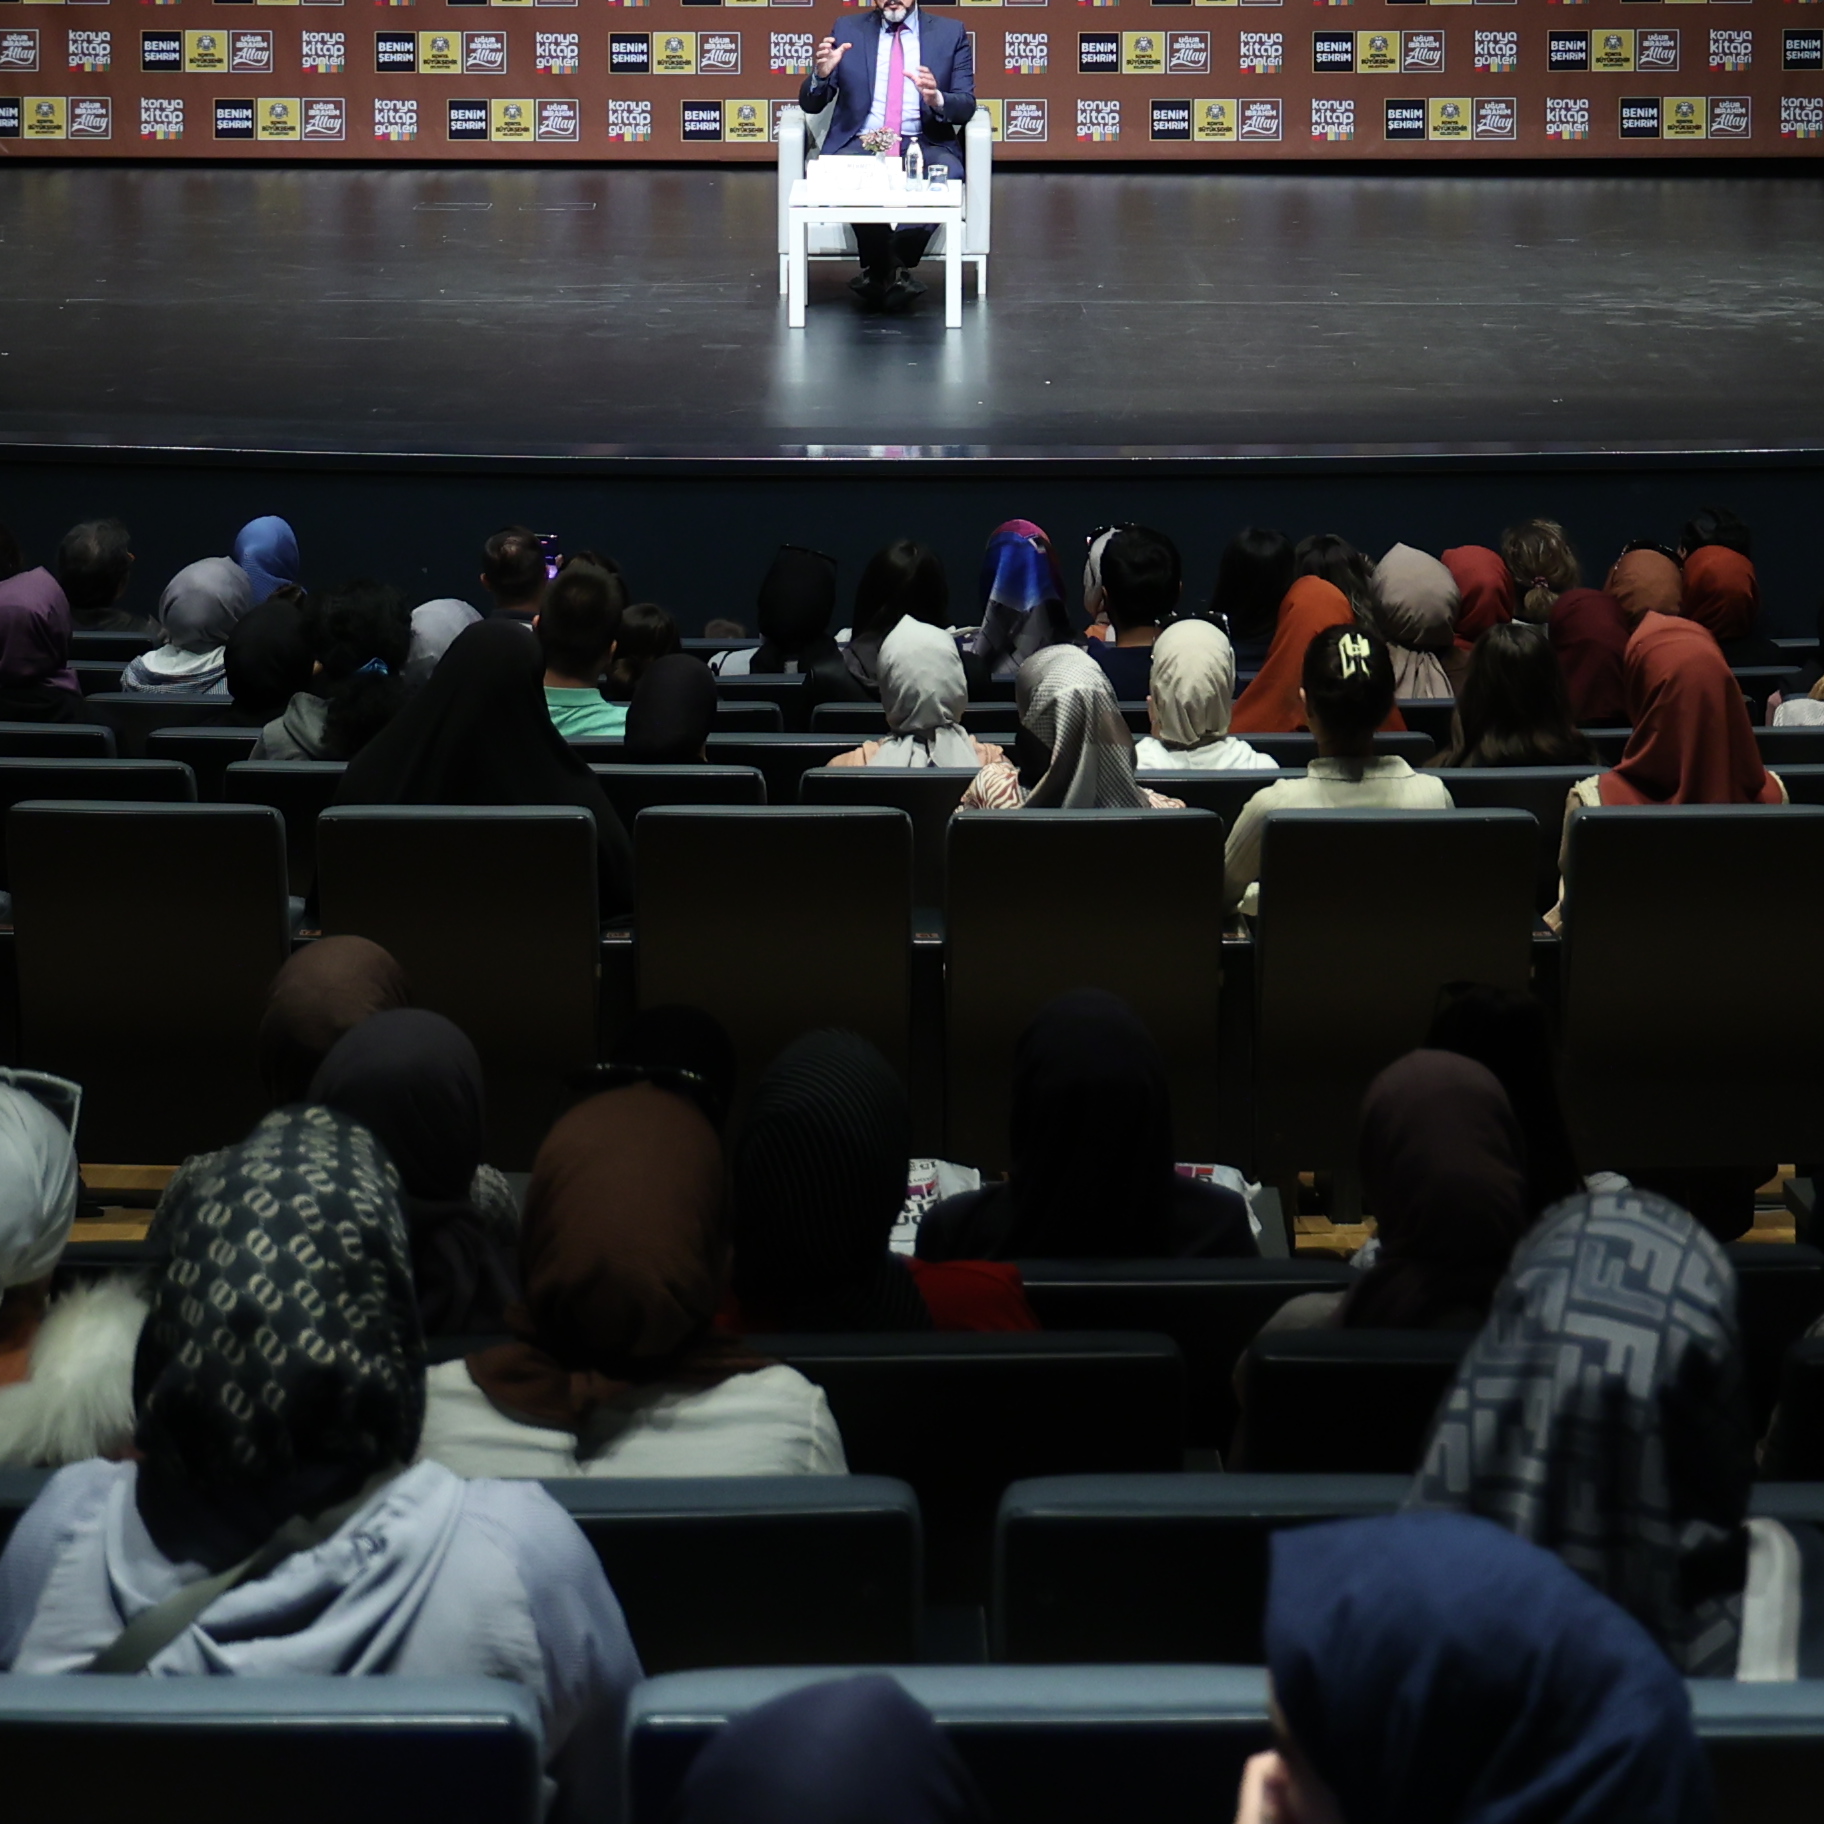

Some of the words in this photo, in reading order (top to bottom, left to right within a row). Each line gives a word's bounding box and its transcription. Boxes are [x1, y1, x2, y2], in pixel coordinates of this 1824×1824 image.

[68, 29, 112, 43] konya
[535, 31, 579, 45] konya
[1004, 31, 1048, 45] konya
[1474, 30, 1518, 44] konya
[68, 42, 112, 56] kitap
[535, 44, 579, 58] kitap
[1004, 44, 1048, 58] kitap
[1474, 43, 1518, 57] kitap
[68, 55, 112, 67] günleri
[535, 57, 579, 69] günleri
[1004, 57, 1048, 69] günleri
[1474, 56, 1518, 68] günleri
[374, 98, 418, 112] konya
[1076, 99, 1120, 113] konya
[1546, 97, 1590, 111] konya
[374, 111, 418, 125] kitap
[1076, 112, 1120, 126] kitap
[1546, 110, 1590, 124] kitap
[374, 124, 418, 136] günleri
[1076, 125, 1120, 137] günleri
[1546, 123, 1590, 135] günleri
